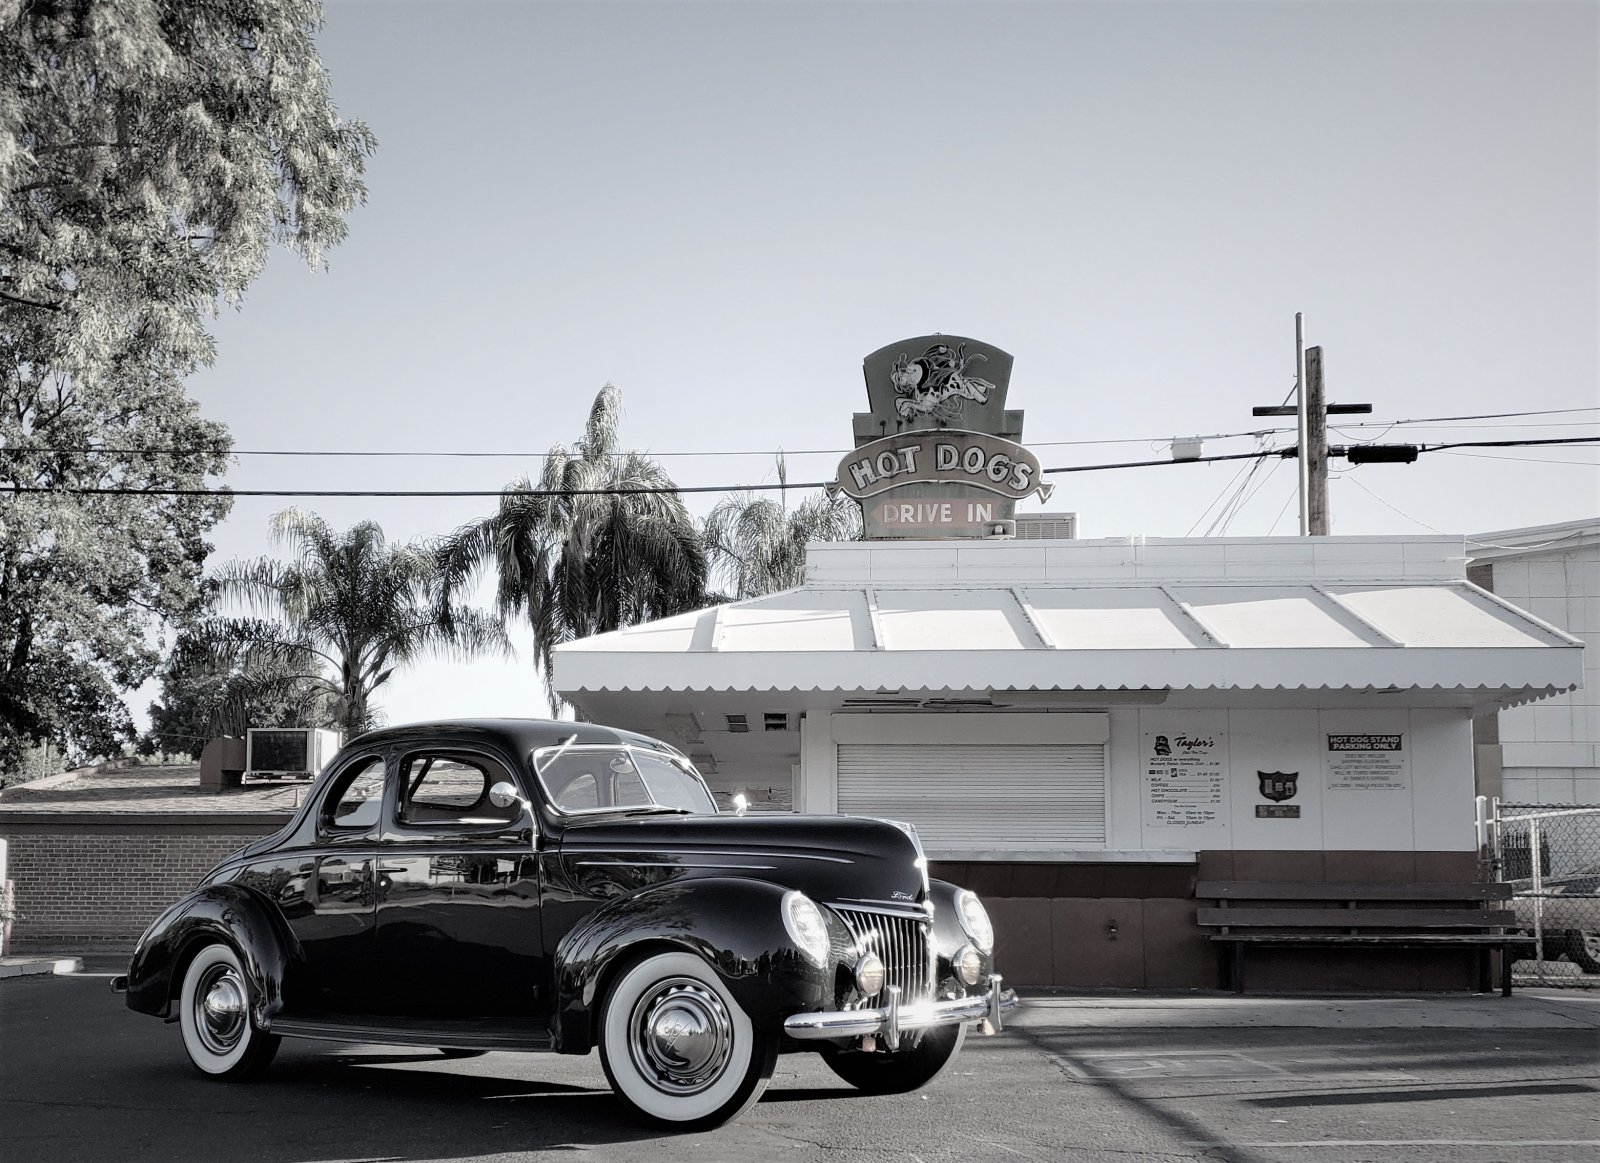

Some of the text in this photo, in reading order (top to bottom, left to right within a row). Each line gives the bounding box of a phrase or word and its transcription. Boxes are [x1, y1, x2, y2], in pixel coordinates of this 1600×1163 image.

[849, 444, 1034, 490] HOT DOGS
[883, 504, 992, 523] DRIVE IN
[1174, 736, 1215, 750] Taylor's
[891, 890, 914, 901] Ford
